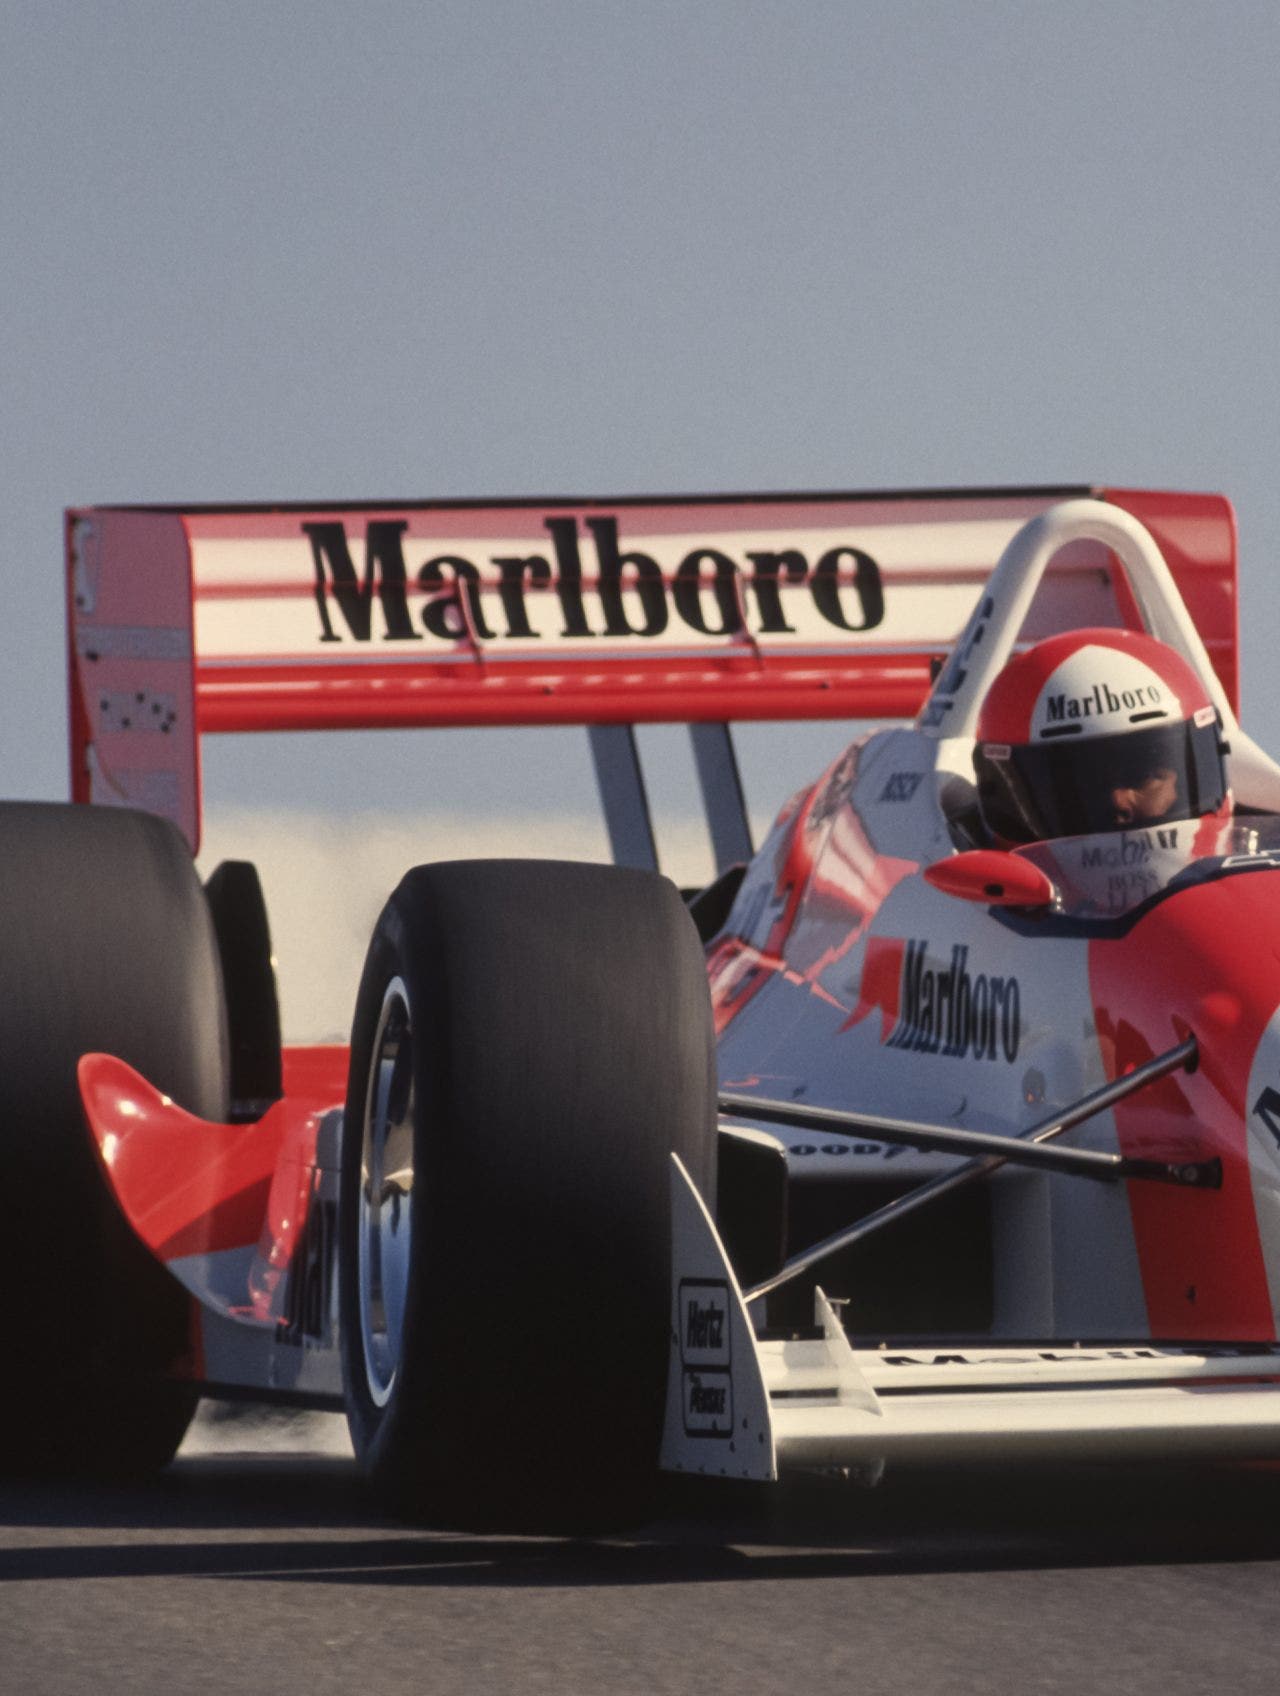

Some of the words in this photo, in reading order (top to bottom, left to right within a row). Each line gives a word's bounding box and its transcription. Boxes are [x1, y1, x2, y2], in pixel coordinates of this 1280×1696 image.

[302, 515, 886, 643] Marlboro
[1046, 684, 1162, 722] Marlboro
[885, 938, 1021, 1065] Marlboro
[687, 1300, 725, 1349] Hertz
